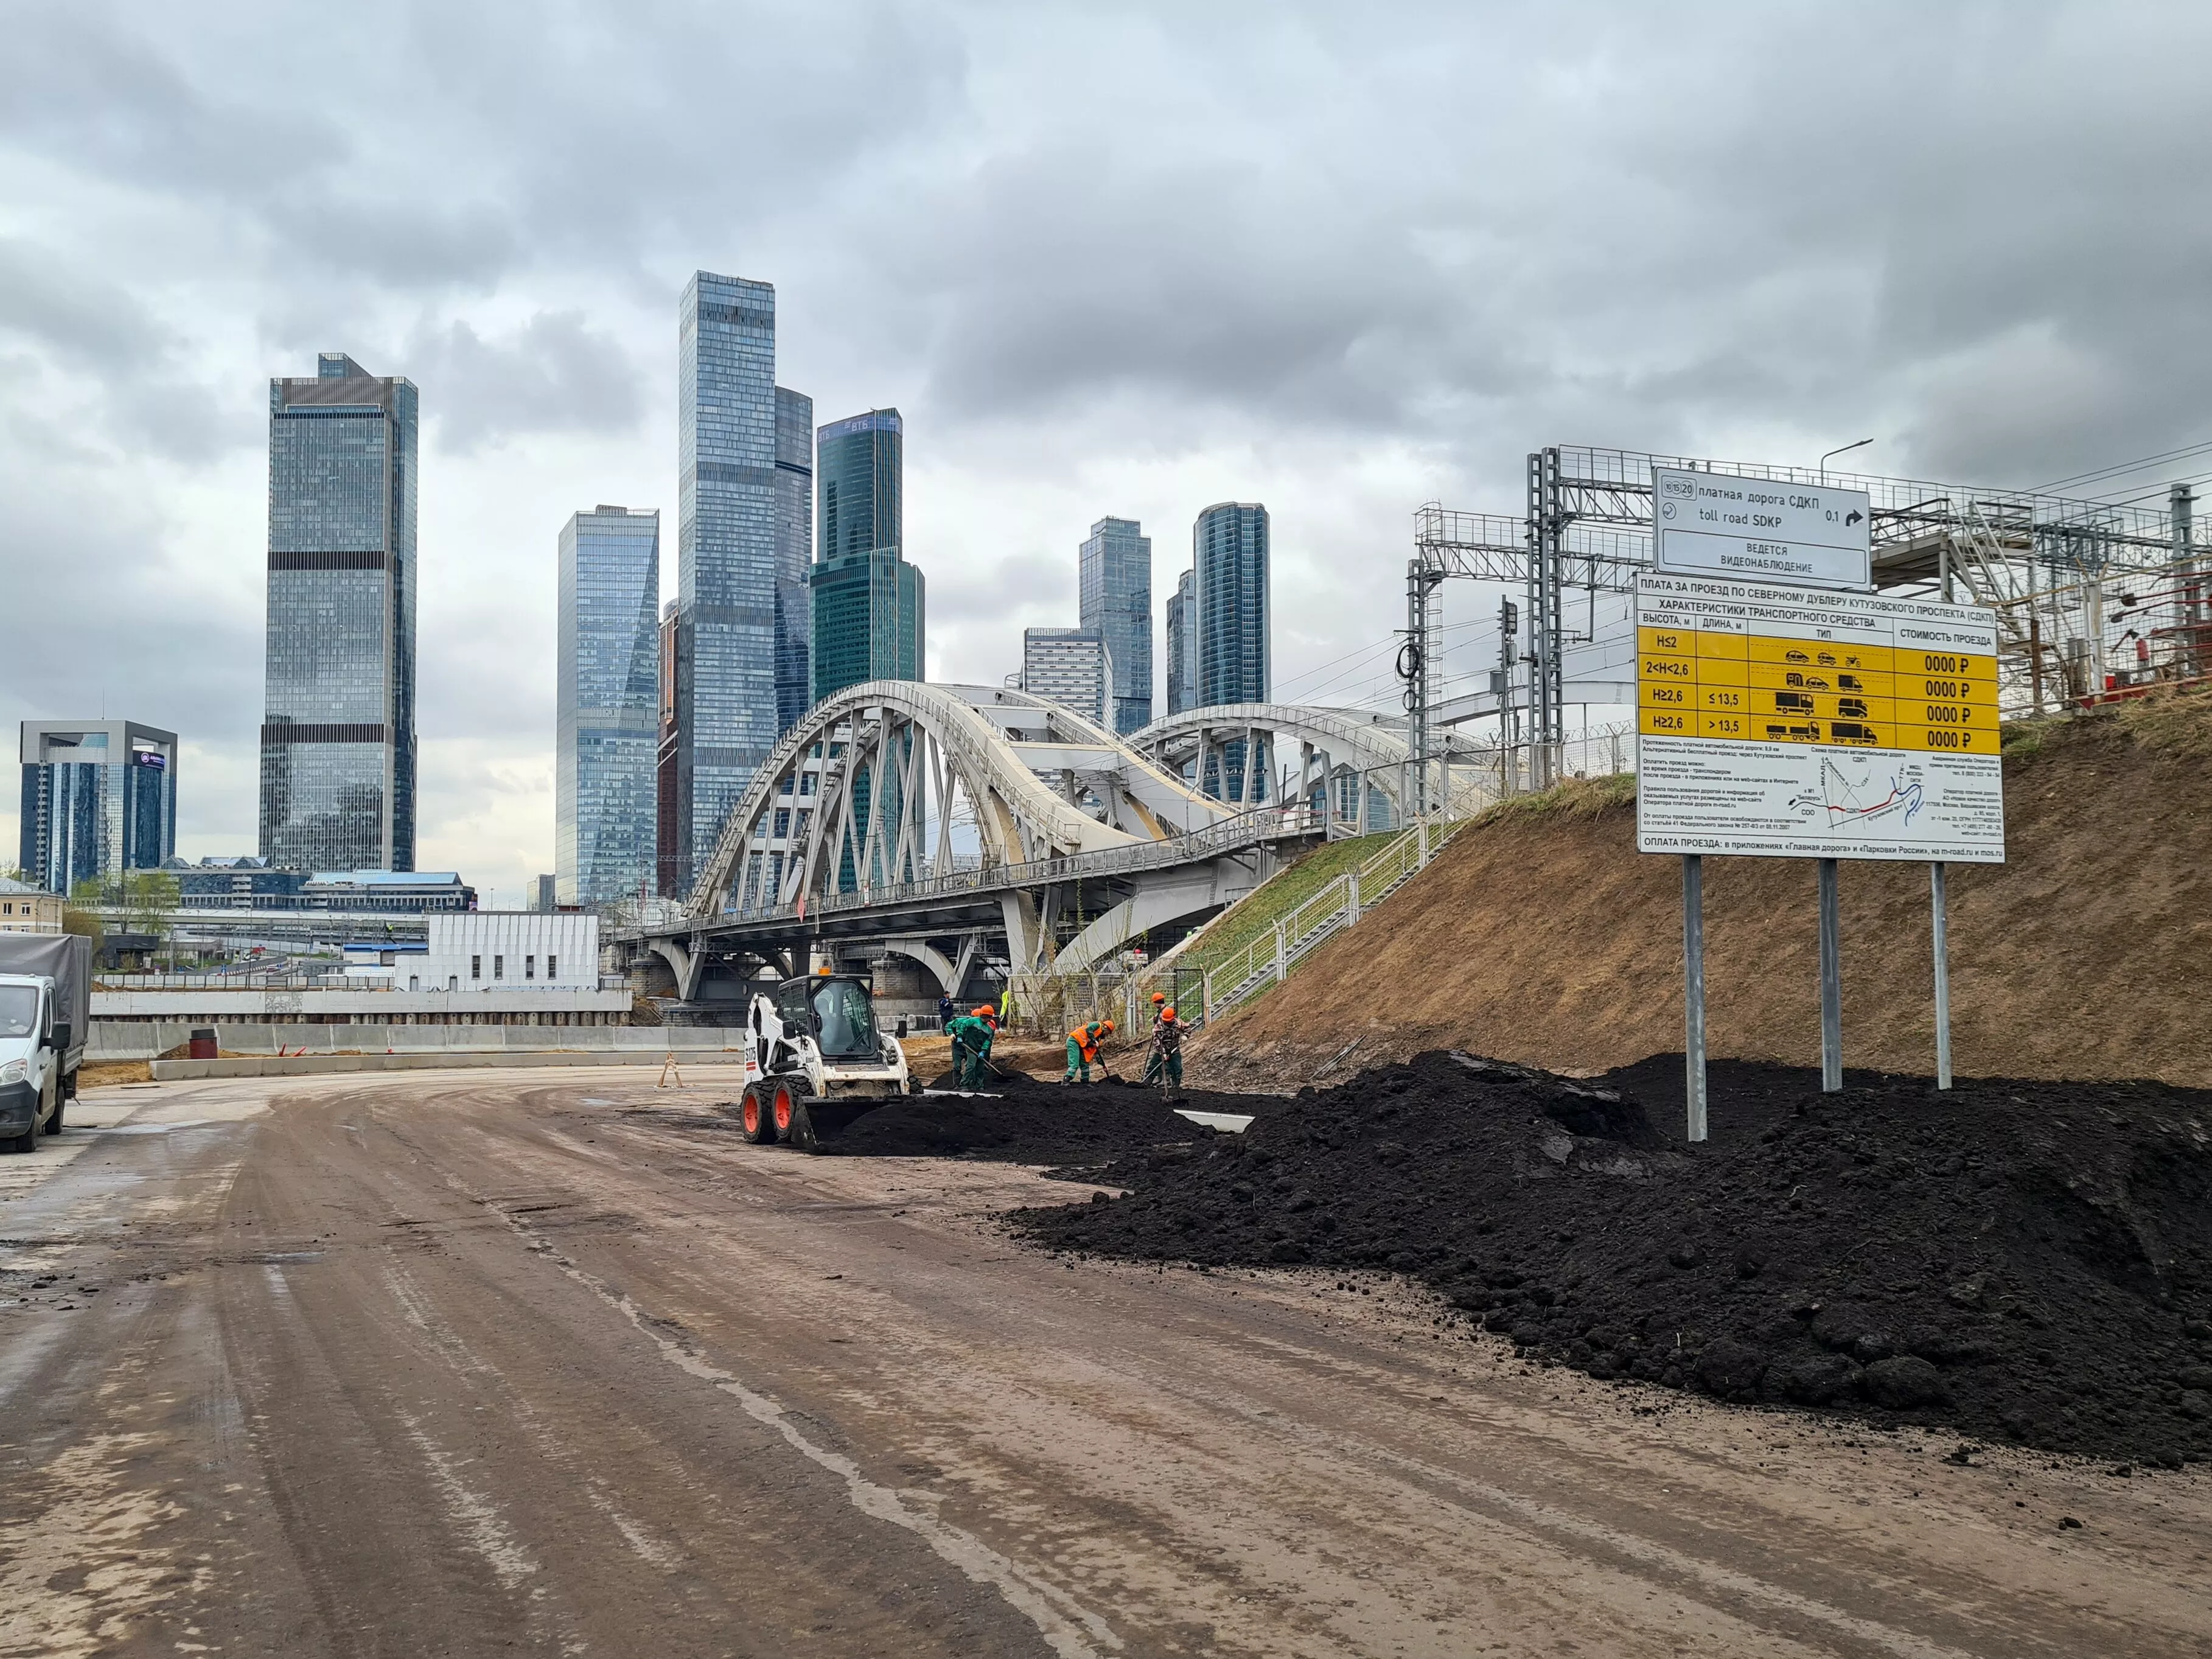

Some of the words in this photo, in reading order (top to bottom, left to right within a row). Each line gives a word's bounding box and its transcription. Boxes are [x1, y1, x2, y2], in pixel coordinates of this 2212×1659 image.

[852, 420, 868, 431] ВТБ
[1682, 484, 1692, 494] 20
[1699, 487, 1742, 500] платная
[1748, 494, 1785, 506] дорога
[1789, 495, 1819, 509] СДКП
[1700, 509, 1718, 521] toll
[1723, 512, 1748, 525] road
[1753, 515, 1782, 528] SDKP
[1746, 543, 1787, 556] ВЕДЕТСЯ
[1721, 556, 1813, 573] ВИДЕОНАБЛЮДЕНИЕ
[1641, 578, 1672, 590] ПЛАТА
[1675, 581, 1688, 592] ЗА
[1690, 583, 1729, 597] ПРОЕЗД
[1731, 587, 1745, 596] ПО
[1747, 588, 1804, 602] СЕВЕРНОМУ
[1806, 594, 1847, 606] ДУБЛЕРУ
[1849, 598, 1914, 613] КУТУЗОВСКОГО
[1916, 606, 1966, 618] ПРОСПЕКТА
[1967, 611, 1994, 624] (СДКП)
[1643, 613, 1681, 626] ВЫСОТА,
[1659, 599, 1745, 615] ХАРАКТЕРИСТИКИ
[1748, 607, 1827, 622] ТРАНСПОРТНОГО
[1829, 614, 1875, 627] СРЕДСТВА
[1702, 618, 1733, 629] ДЛИНА,
[1816, 629, 1831, 638] ТИП
[1900, 629, 1952, 641] СТОИМОСТЬ
[1953, 634, 1992, 646] ПРОЕЗДА
[1925, 655, 1955, 672] 0000
[1961, 658, 1969, 673] ₽
[1926, 680, 1956, 697] 0000
[1961, 683, 1969, 697] ₽
[1718, 693, 1738, 707] 13,5
[1927, 705, 1957, 722] 0000
[1962, 708, 1970, 723] ₽
[1718, 719, 1739, 733] 13,5
[1928, 730, 1958, 747] 0000
[1963, 733, 1970, 747] ₽
[1644, 837, 1678, 846] ОПЛАТА
[1681, 838, 1722, 848] ПРОЕЗДА:
[1785, 842, 1819, 850] «Главная
[1859, 844, 1896, 854] «Парковки
[1898, 845, 1930, 855] России»,
[746, 1047, 756, 1061] S175
